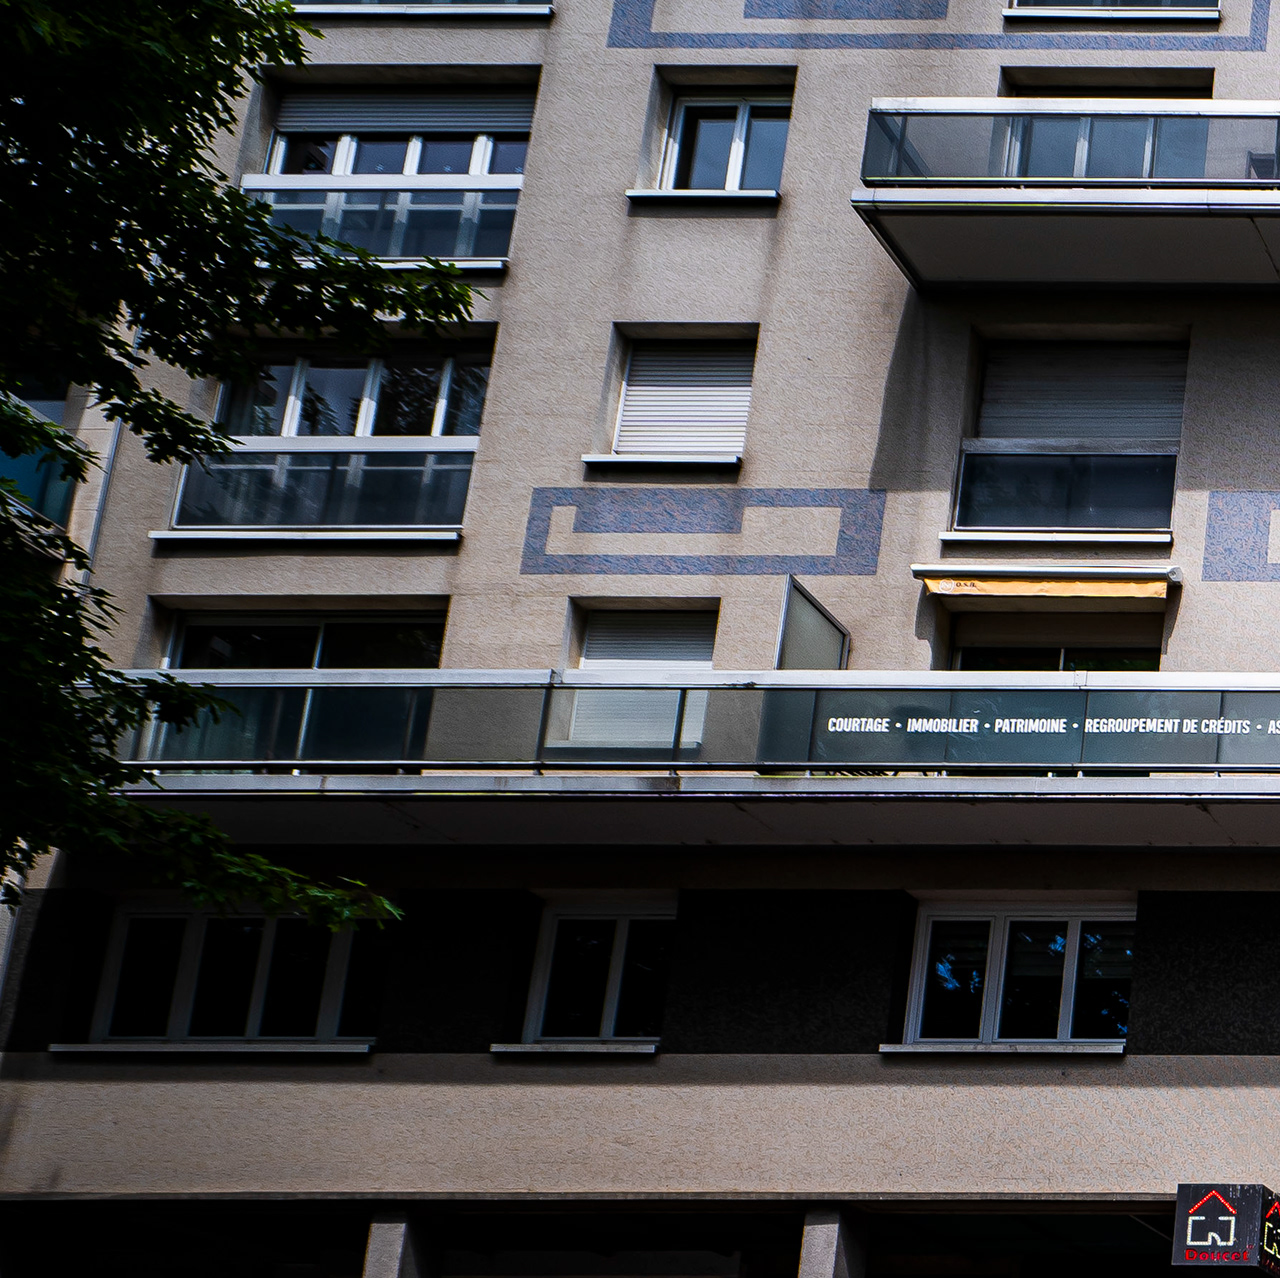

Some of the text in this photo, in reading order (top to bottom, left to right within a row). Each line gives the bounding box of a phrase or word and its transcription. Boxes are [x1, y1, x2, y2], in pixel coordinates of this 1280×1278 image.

[828, 717, 891, 733] COURTAGE
[906, 717, 979, 733] IMMOBILIER
[994, 717, 1068, 733] PATRIMOINE
[1084, 717, 1181, 734] REGROUPEMENT
[1182, 718, 1199, 734] DE
[1200, 715, 1251, 734] CRÉDITS
[1185, 1249, 1249, 1261] Doucet
